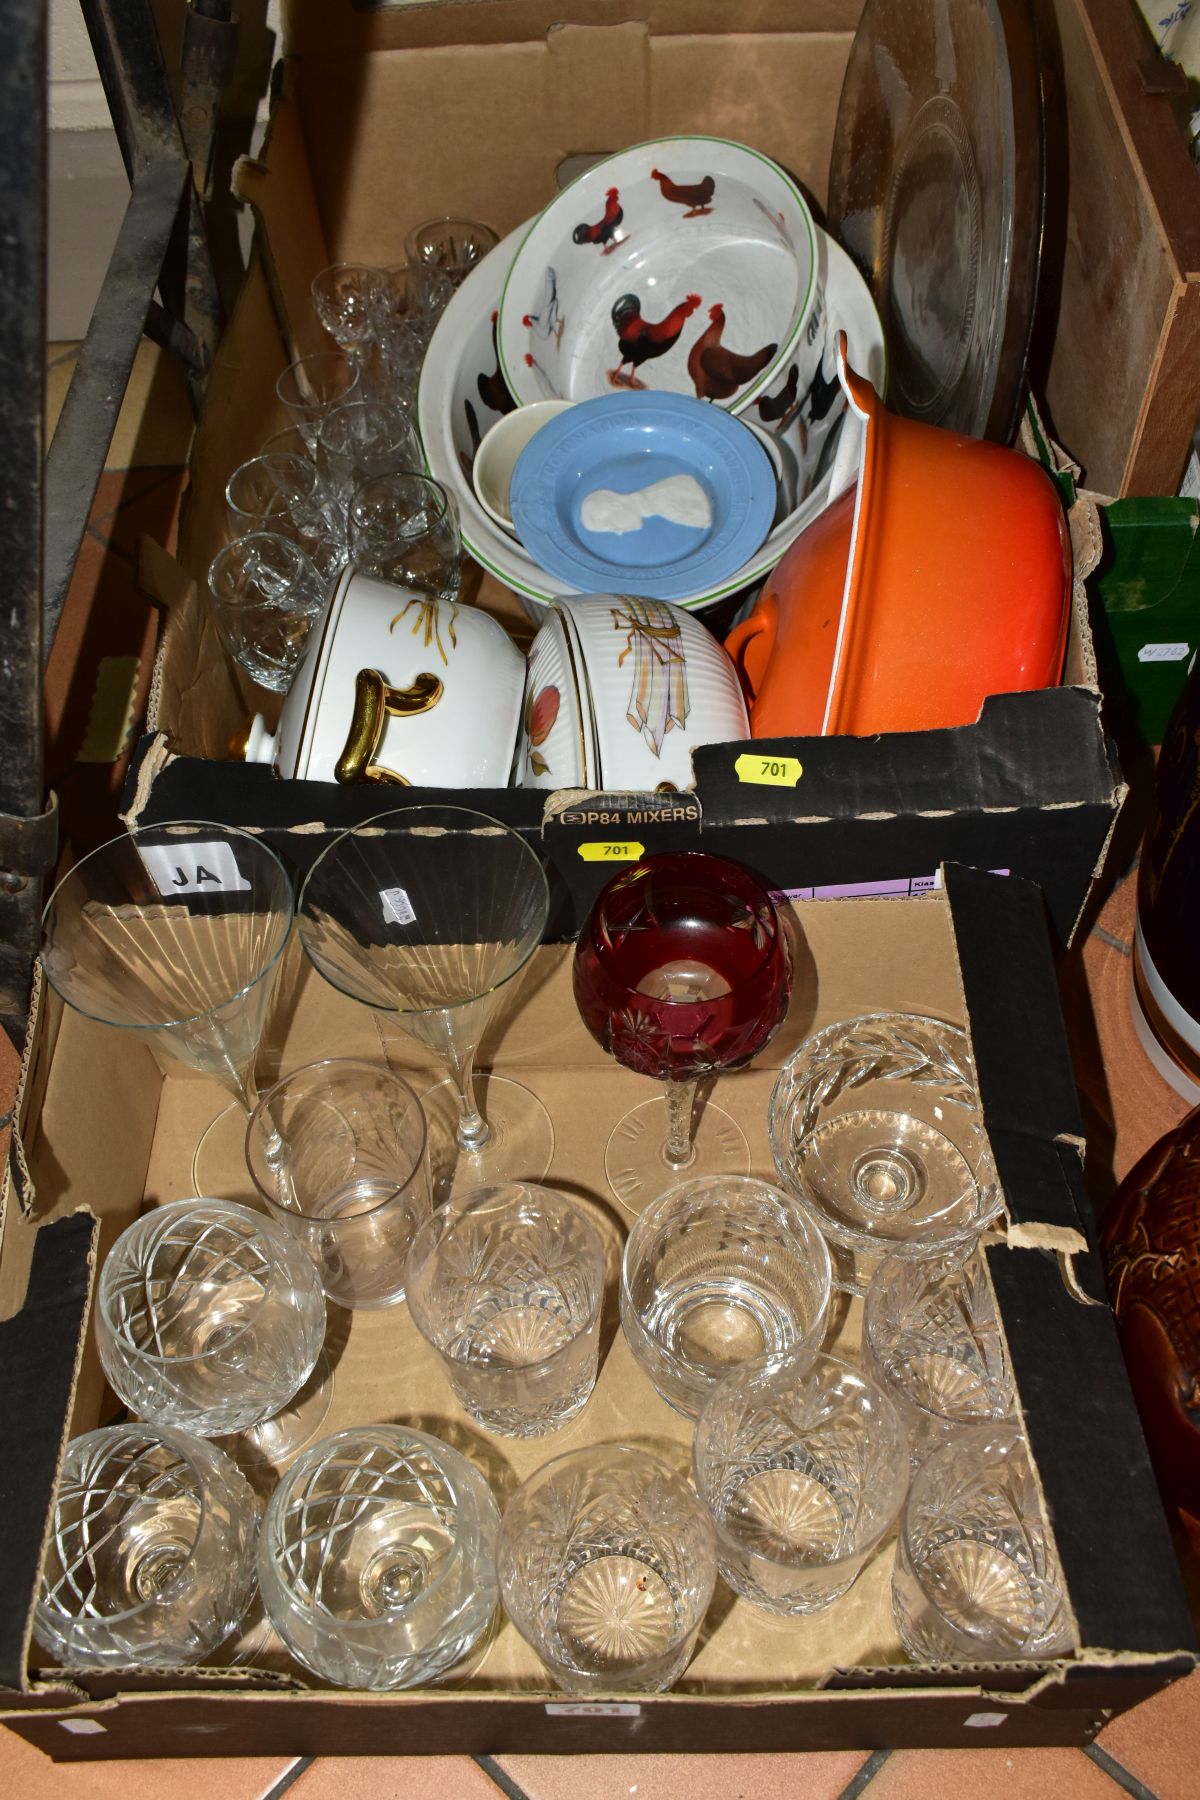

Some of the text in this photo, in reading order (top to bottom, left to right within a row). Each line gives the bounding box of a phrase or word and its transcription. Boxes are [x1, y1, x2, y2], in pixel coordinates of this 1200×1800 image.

[760, 762, 787, 777] 701
[587, 805, 698, 825] P84 MIXERS
[603, 845, 628, 856] 701
